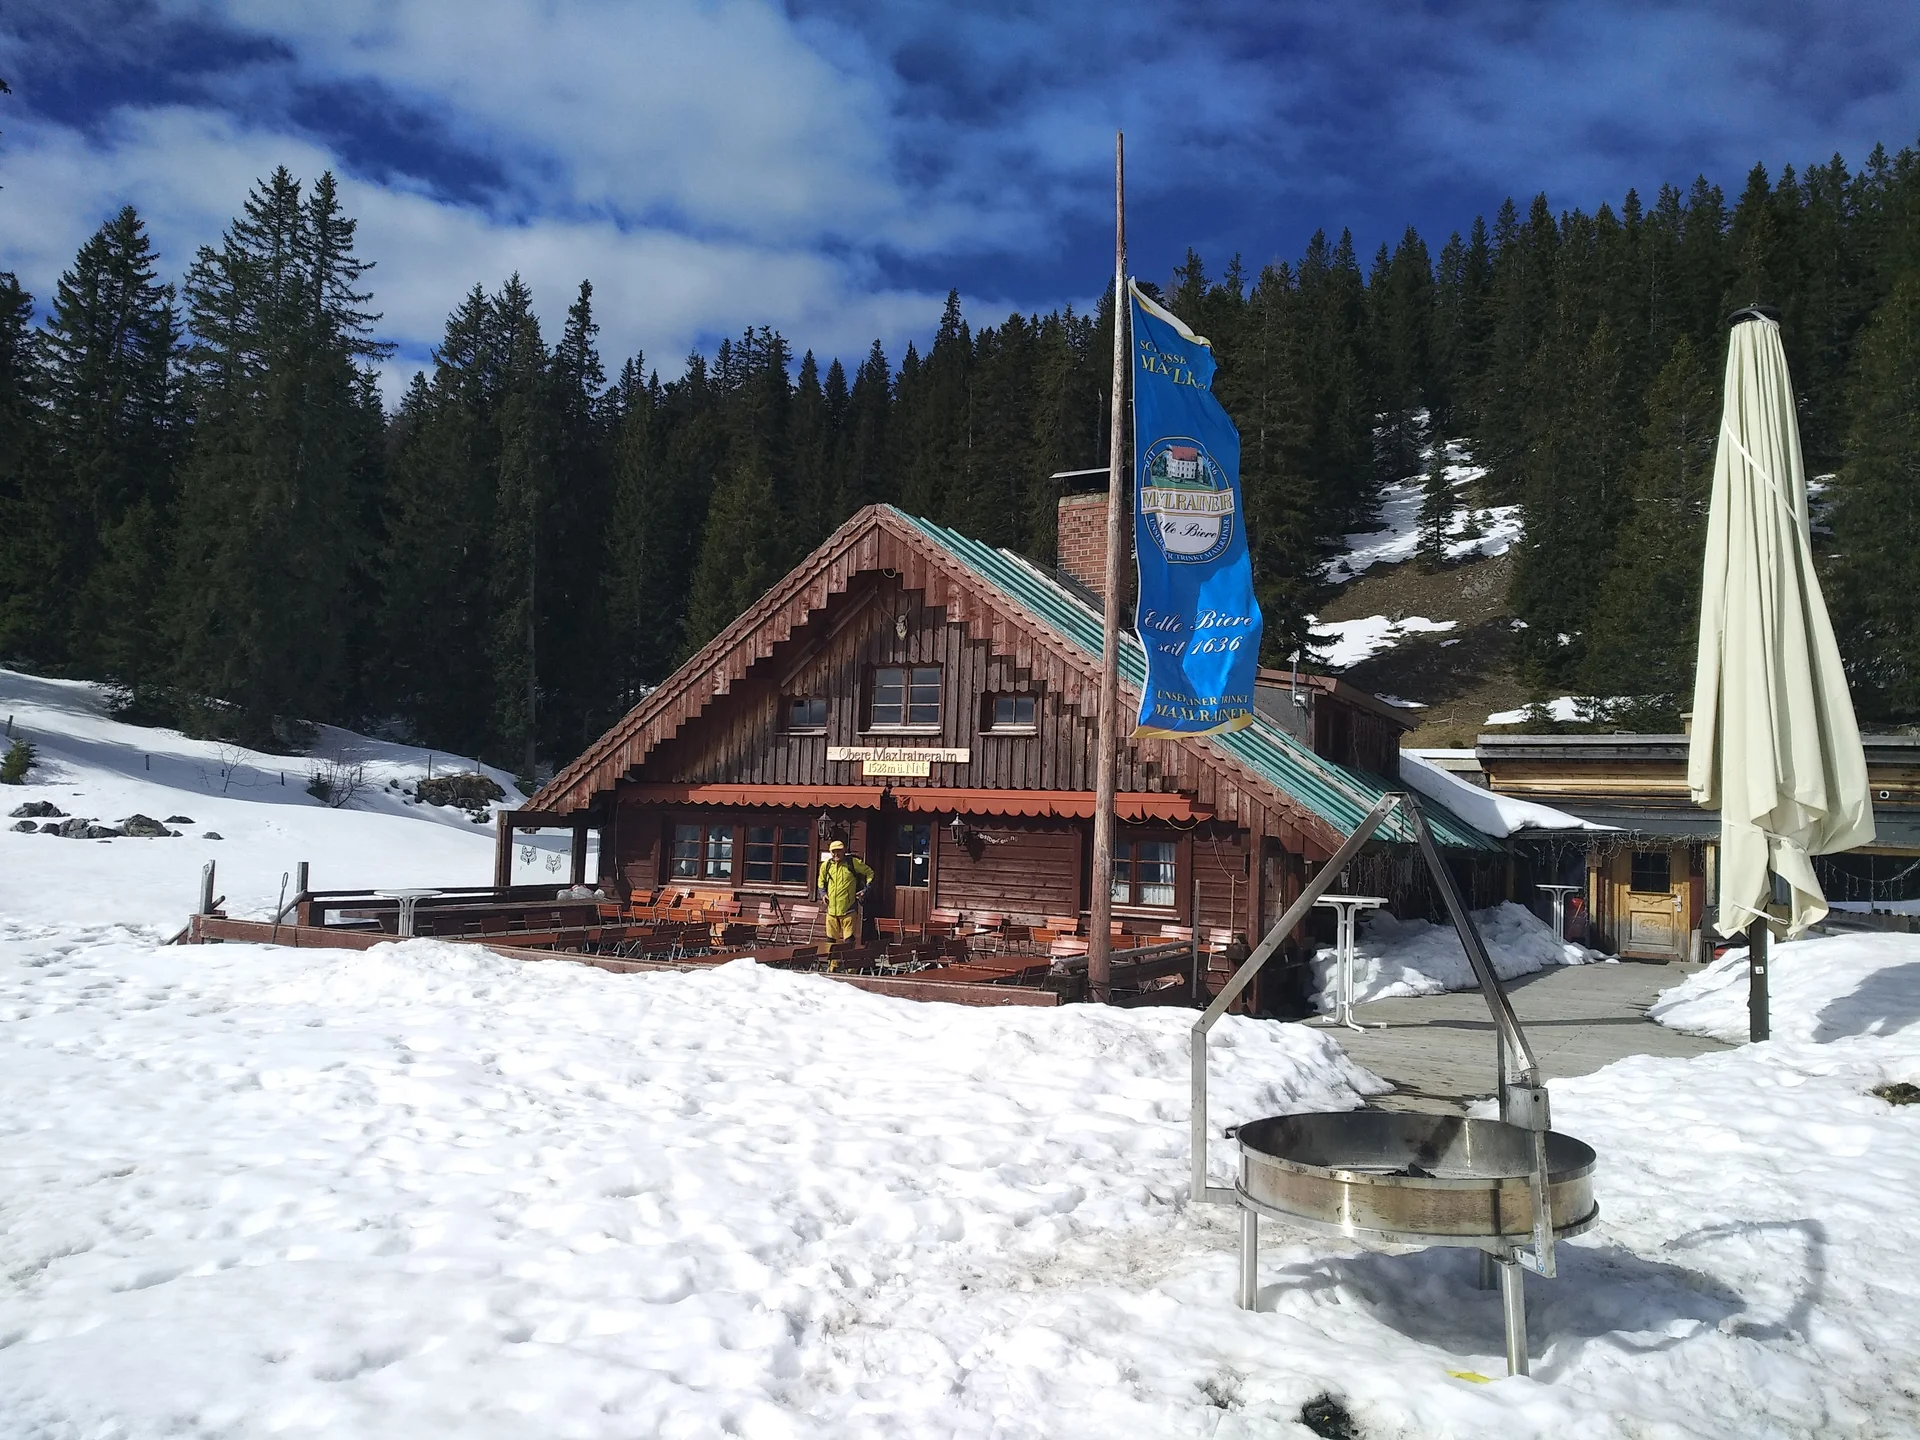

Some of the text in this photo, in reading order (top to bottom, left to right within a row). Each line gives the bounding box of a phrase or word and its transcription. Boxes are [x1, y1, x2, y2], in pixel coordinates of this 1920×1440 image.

[1180, 522, 1217, 539] Biere
[1143, 608, 1254, 634] Edle Biere
[1157, 635, 1245, 657] seit 1636
[838, 747, 957, 763] Obere Maxlraineralm
